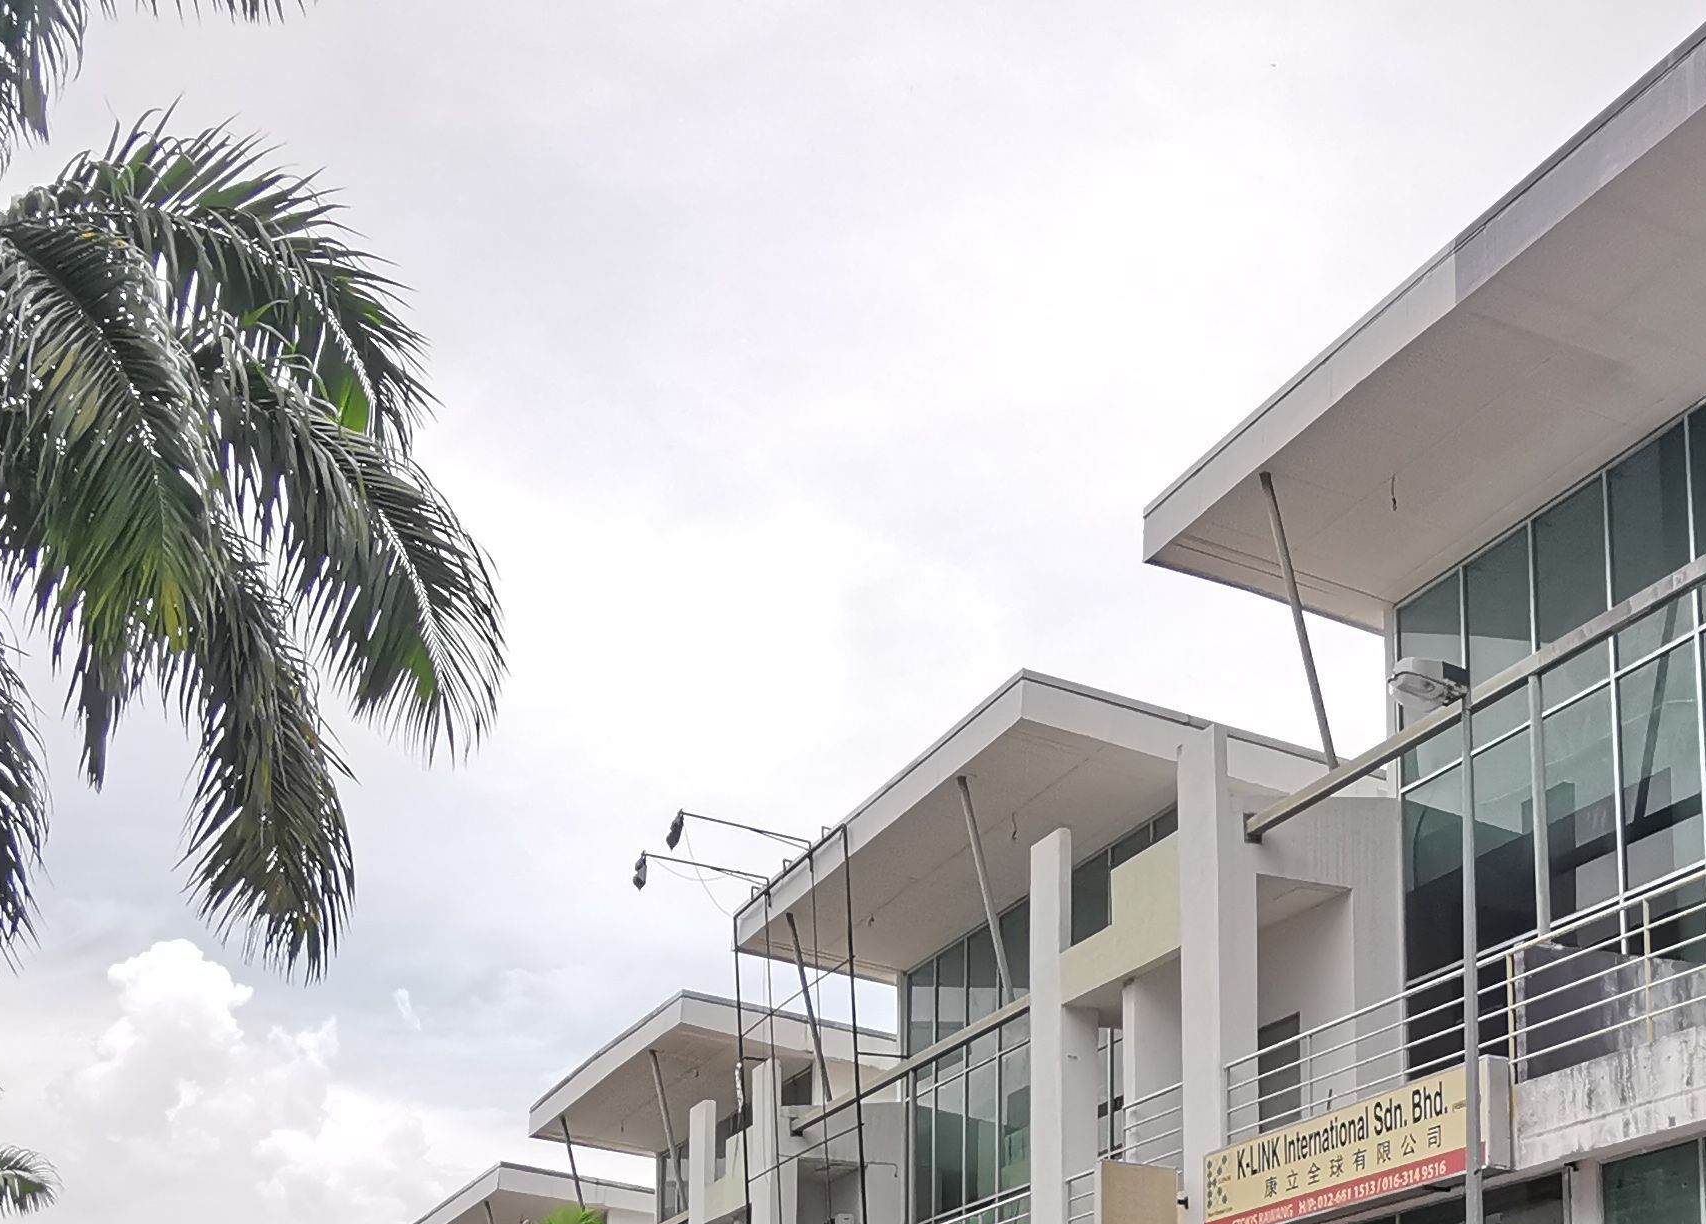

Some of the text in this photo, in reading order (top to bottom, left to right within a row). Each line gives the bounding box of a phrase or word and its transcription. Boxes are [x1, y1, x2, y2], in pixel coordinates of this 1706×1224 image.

[1236, 1080, 1448, 1180] K-LINK International Sdn. Bhd.
